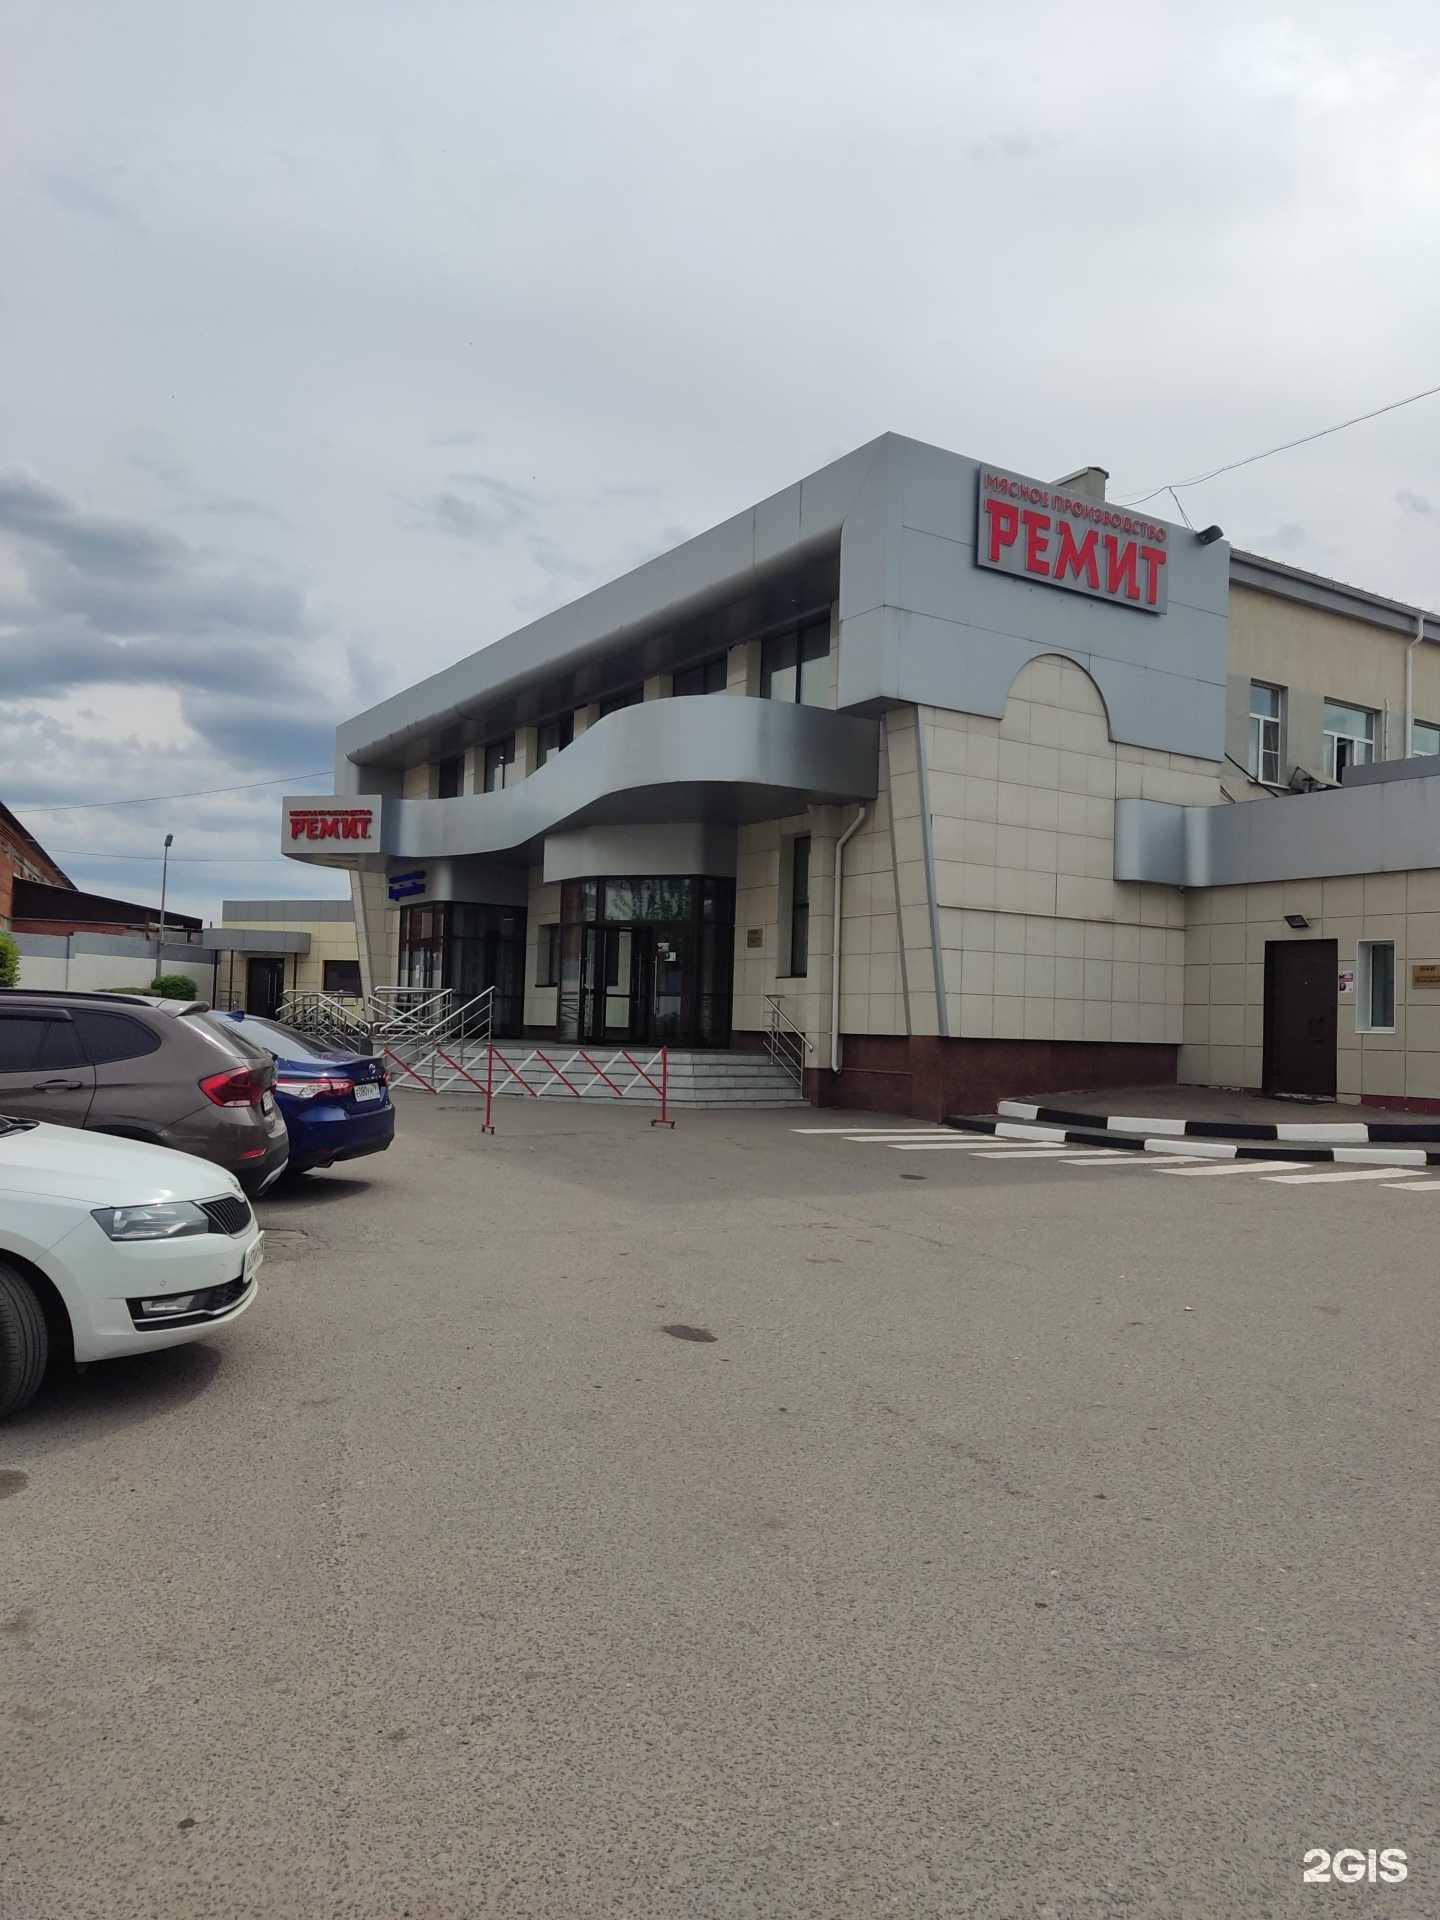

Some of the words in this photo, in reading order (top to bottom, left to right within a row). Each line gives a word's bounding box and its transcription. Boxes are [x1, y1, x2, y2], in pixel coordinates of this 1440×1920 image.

[985, 472, 1049, 507] МЯСНОЕ
[1051, 495, 1167, 543] ПРОИЗВОДСТВО
[986, 499, 1167, 605] РЕМИТ
[290, 817, 372, 840] РЕМИТ
